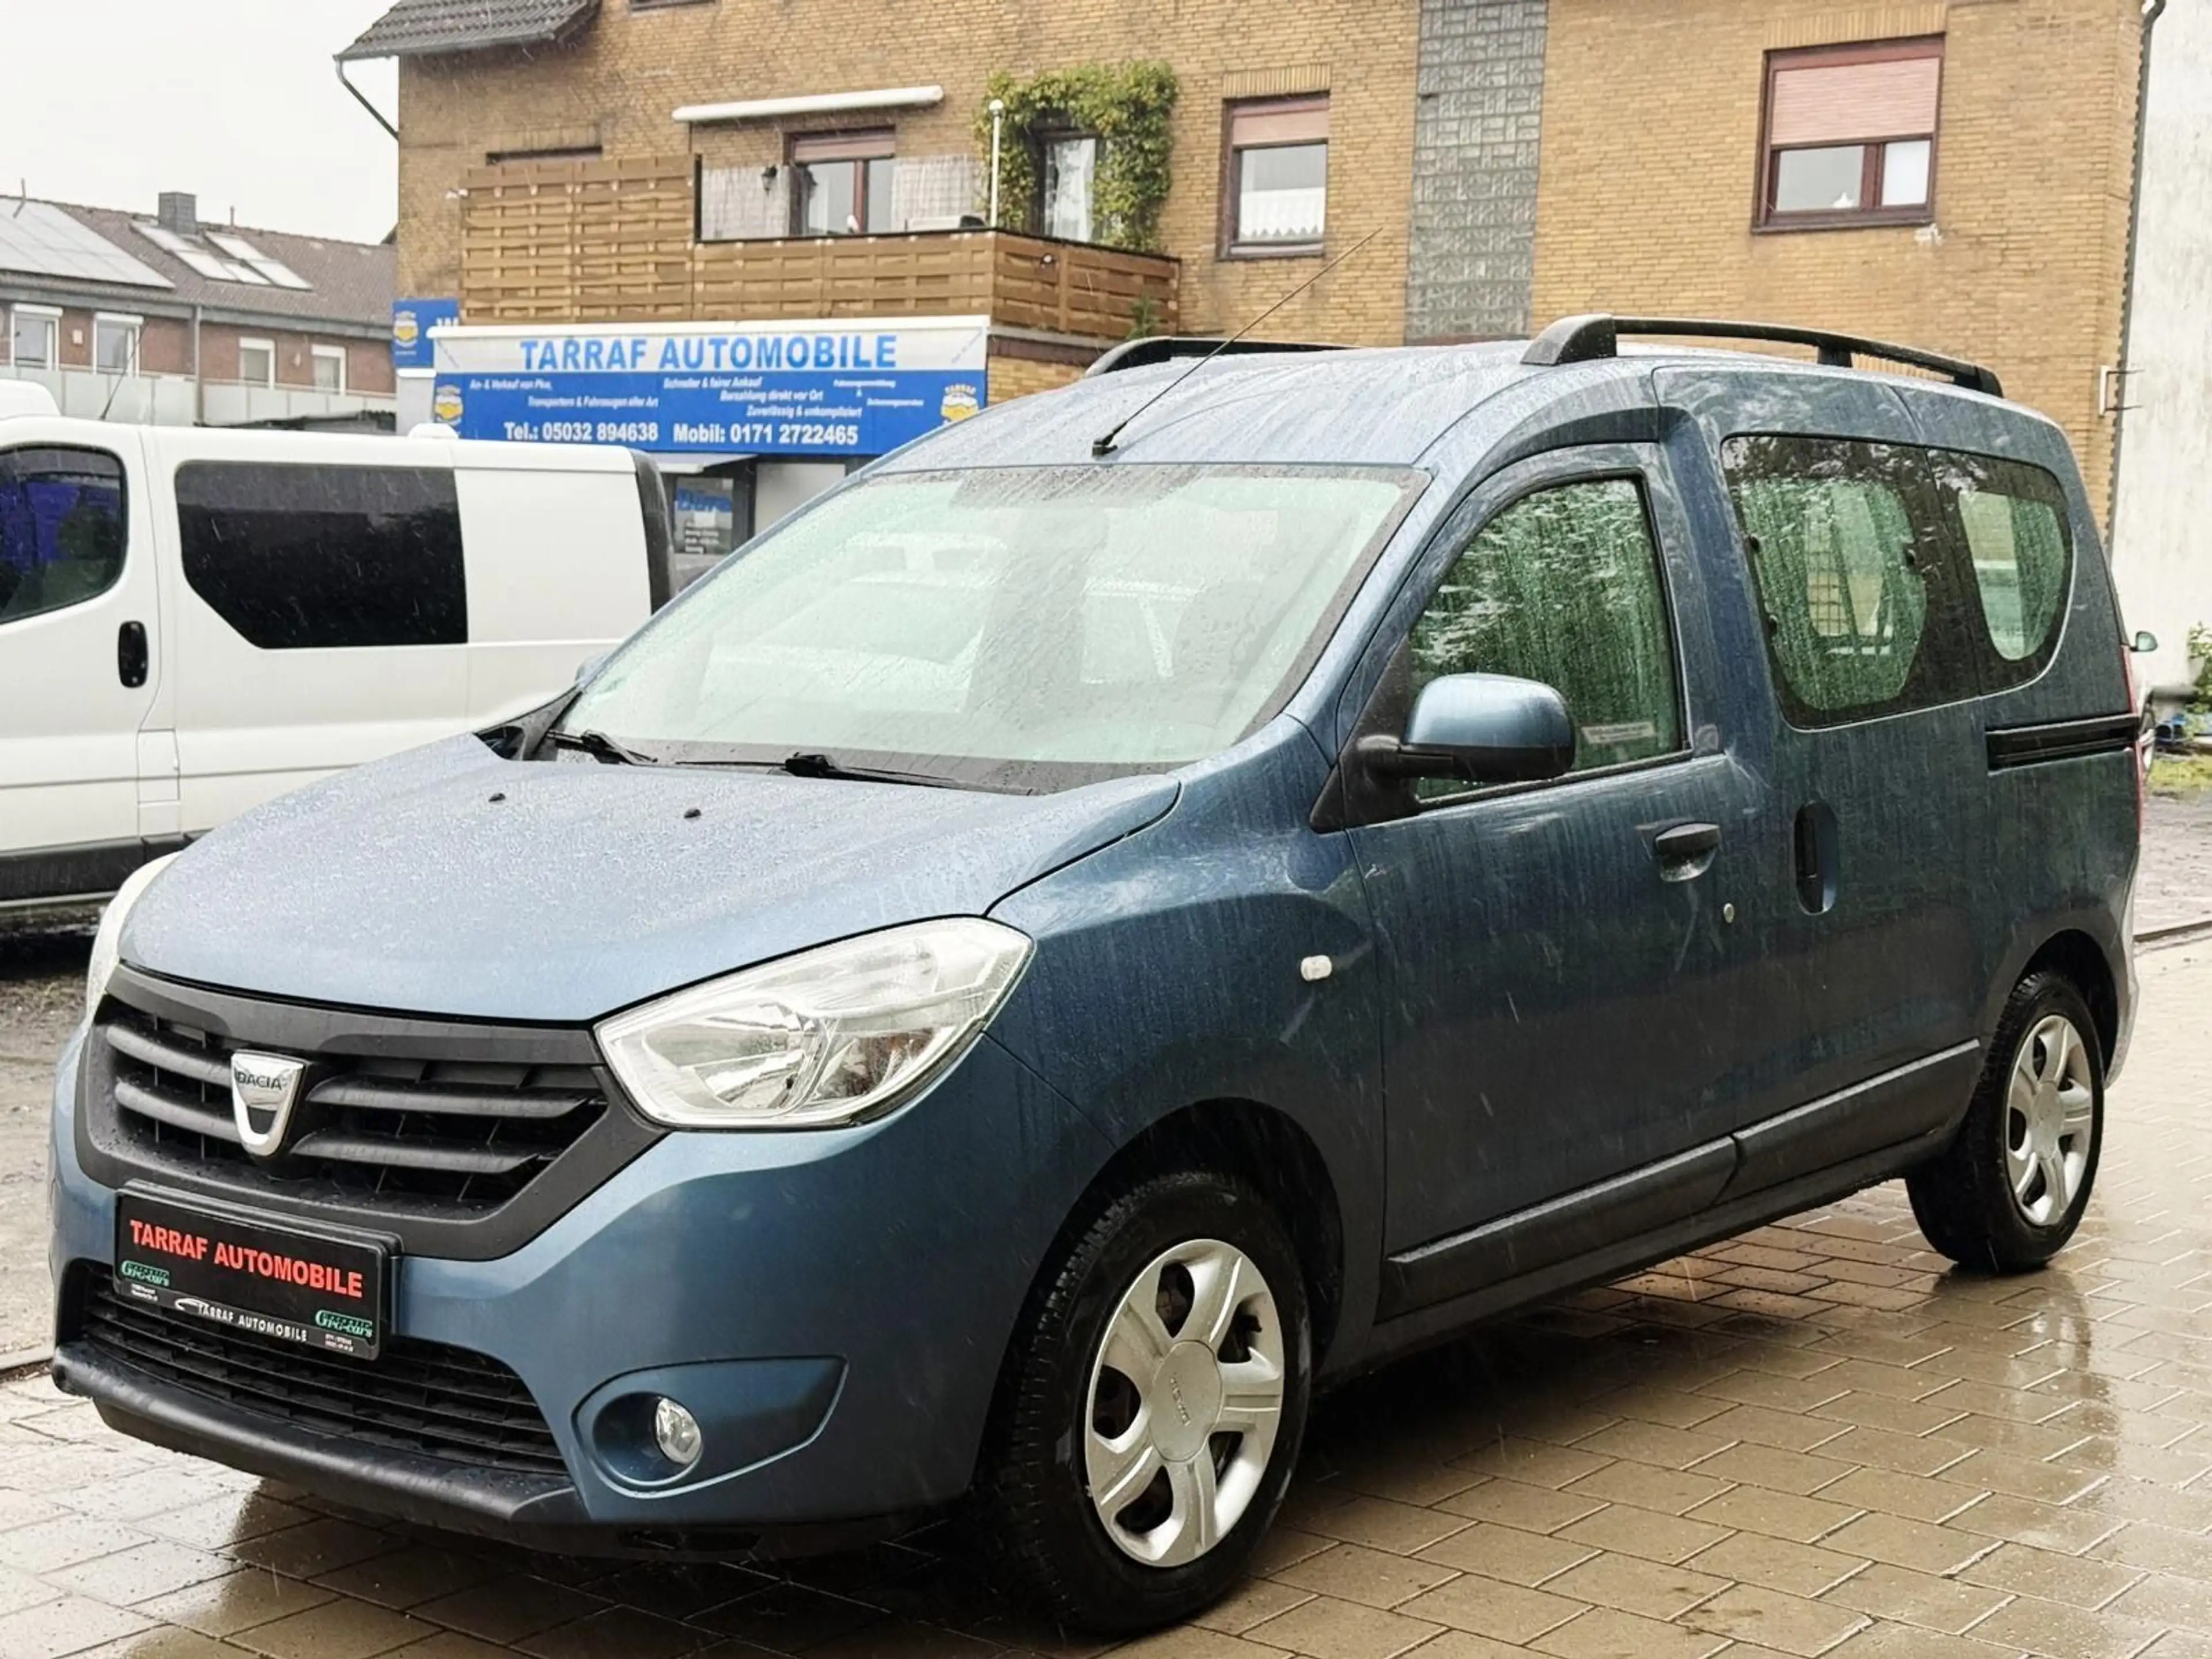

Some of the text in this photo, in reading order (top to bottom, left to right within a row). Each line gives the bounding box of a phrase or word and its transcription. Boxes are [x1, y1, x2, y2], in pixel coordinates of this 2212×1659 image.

[520, 334, 897, 370] TARRAF AUTOMOBILE
[720, 389, 824, 404] Barzahlung direkt vor Ort
[503, 422, 858, 445] Tel.: 05032 894638 Mobil: 0171 2722465
[237, 1071, 282, 1090] DACIA
[130, 1219, 363, 1298] TARRAF AUTOMOBILE
[198, 1302, 233, 1324] TARRAF
[238, 1315, 308, 1343] AUTOMOBILE
